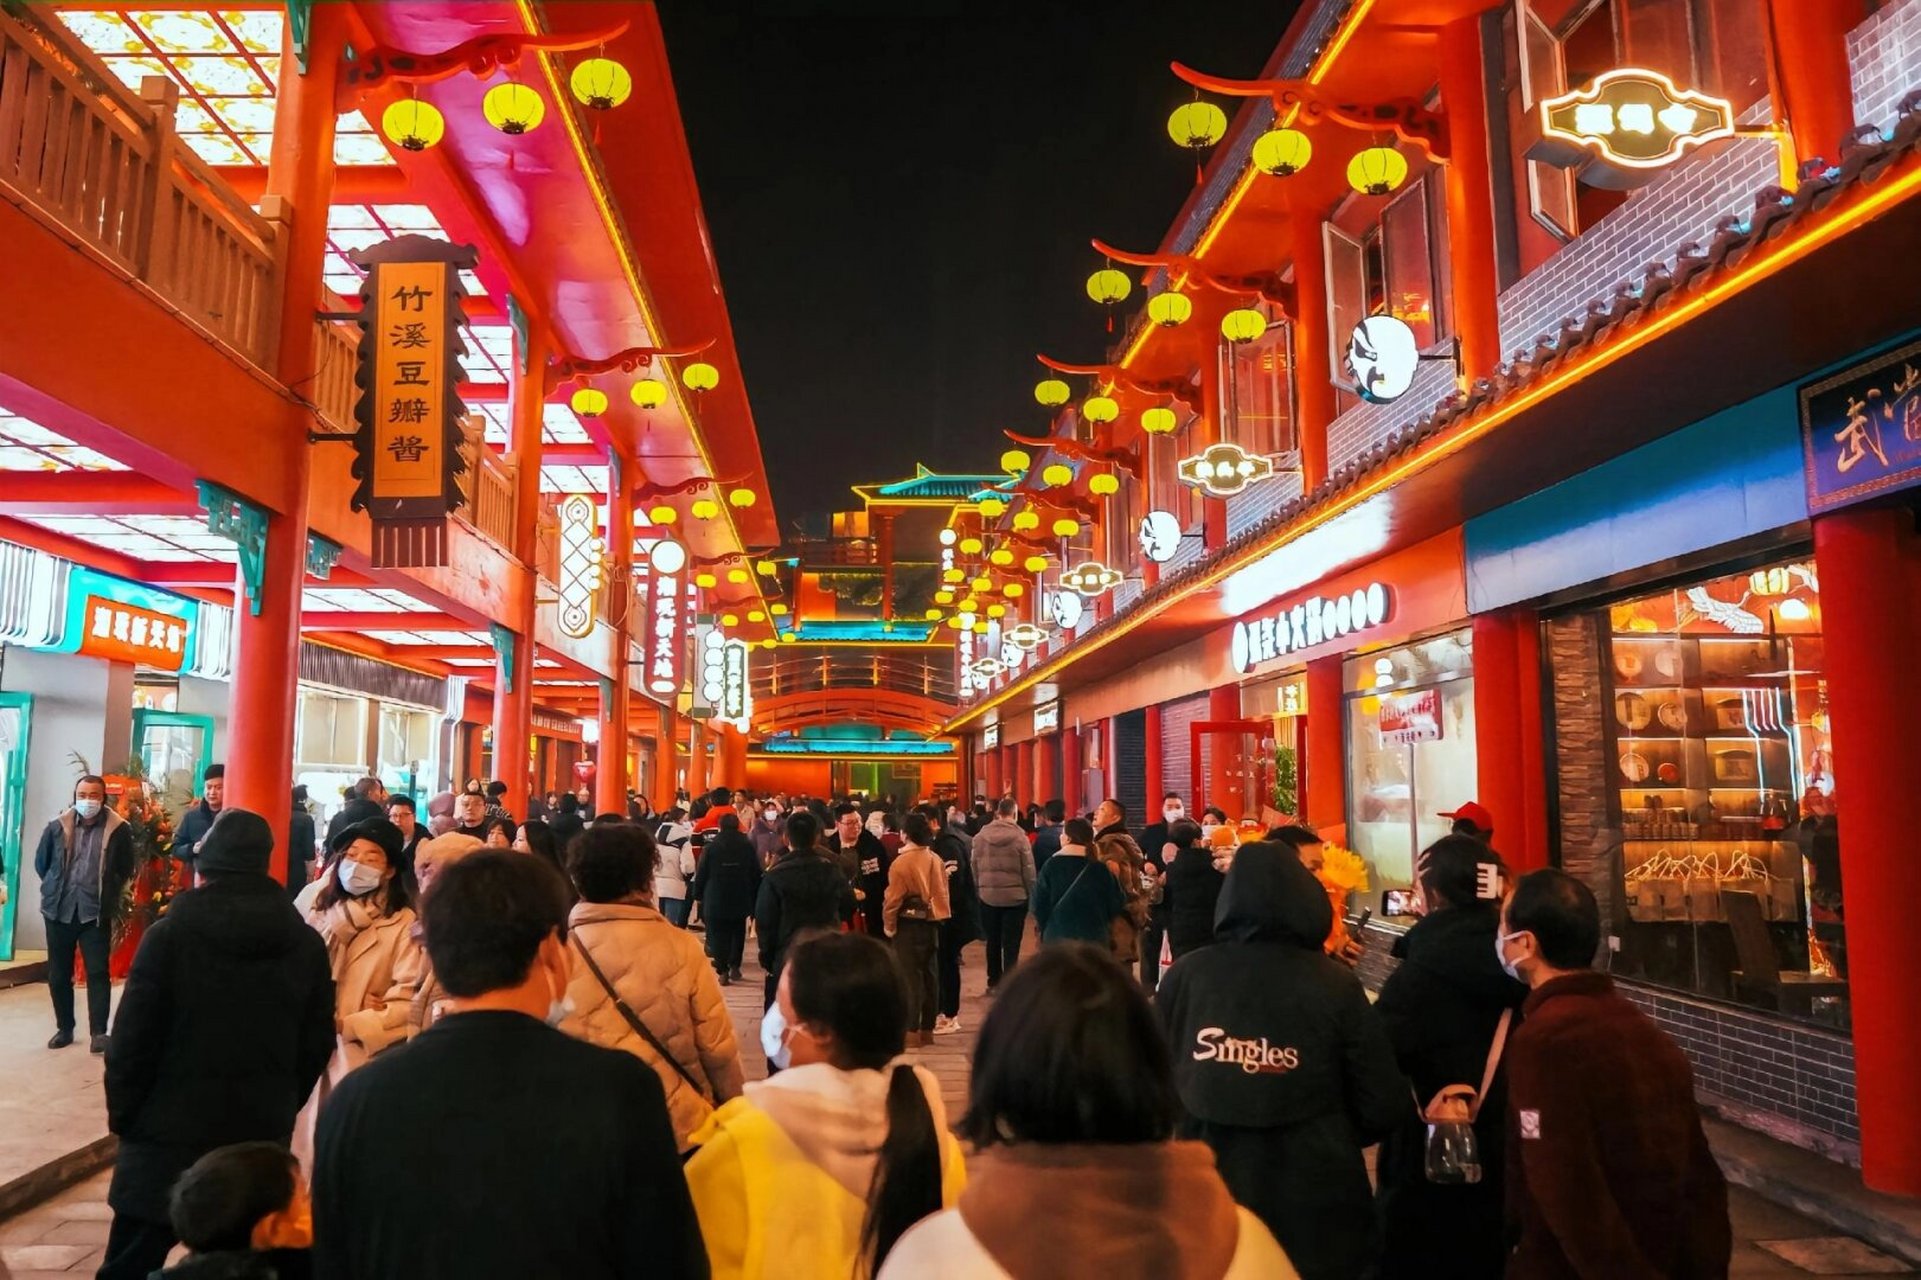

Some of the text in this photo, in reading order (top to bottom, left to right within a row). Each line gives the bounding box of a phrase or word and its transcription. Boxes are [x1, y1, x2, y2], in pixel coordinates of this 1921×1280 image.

[387, 284, 434, 463] 竹溪豆瓣酱
[1193, 1027, 1299, 1074] Singles
